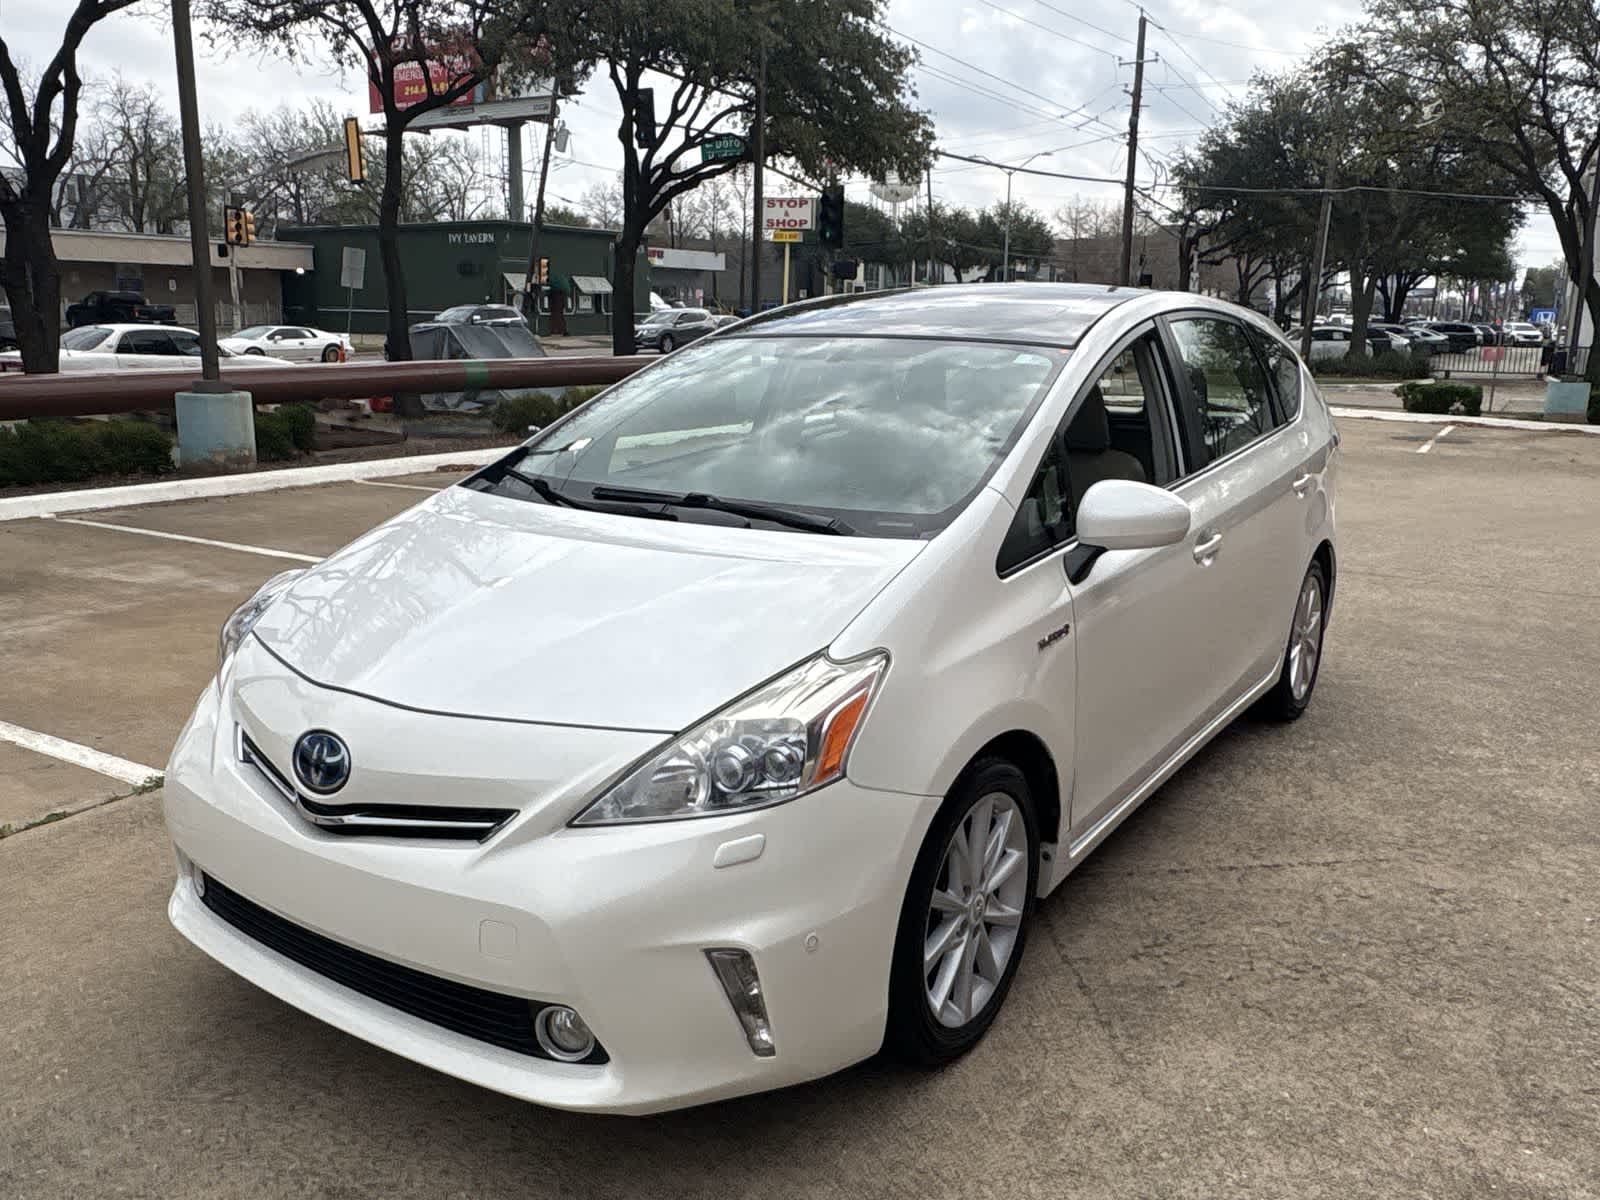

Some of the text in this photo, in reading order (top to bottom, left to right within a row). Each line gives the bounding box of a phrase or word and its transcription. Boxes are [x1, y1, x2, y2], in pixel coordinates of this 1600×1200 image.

[767, 199, 808, 208] STOP
[767, 218, 808, 228] SHOP
[448, 232, 495, 243] IVY TAVERN
